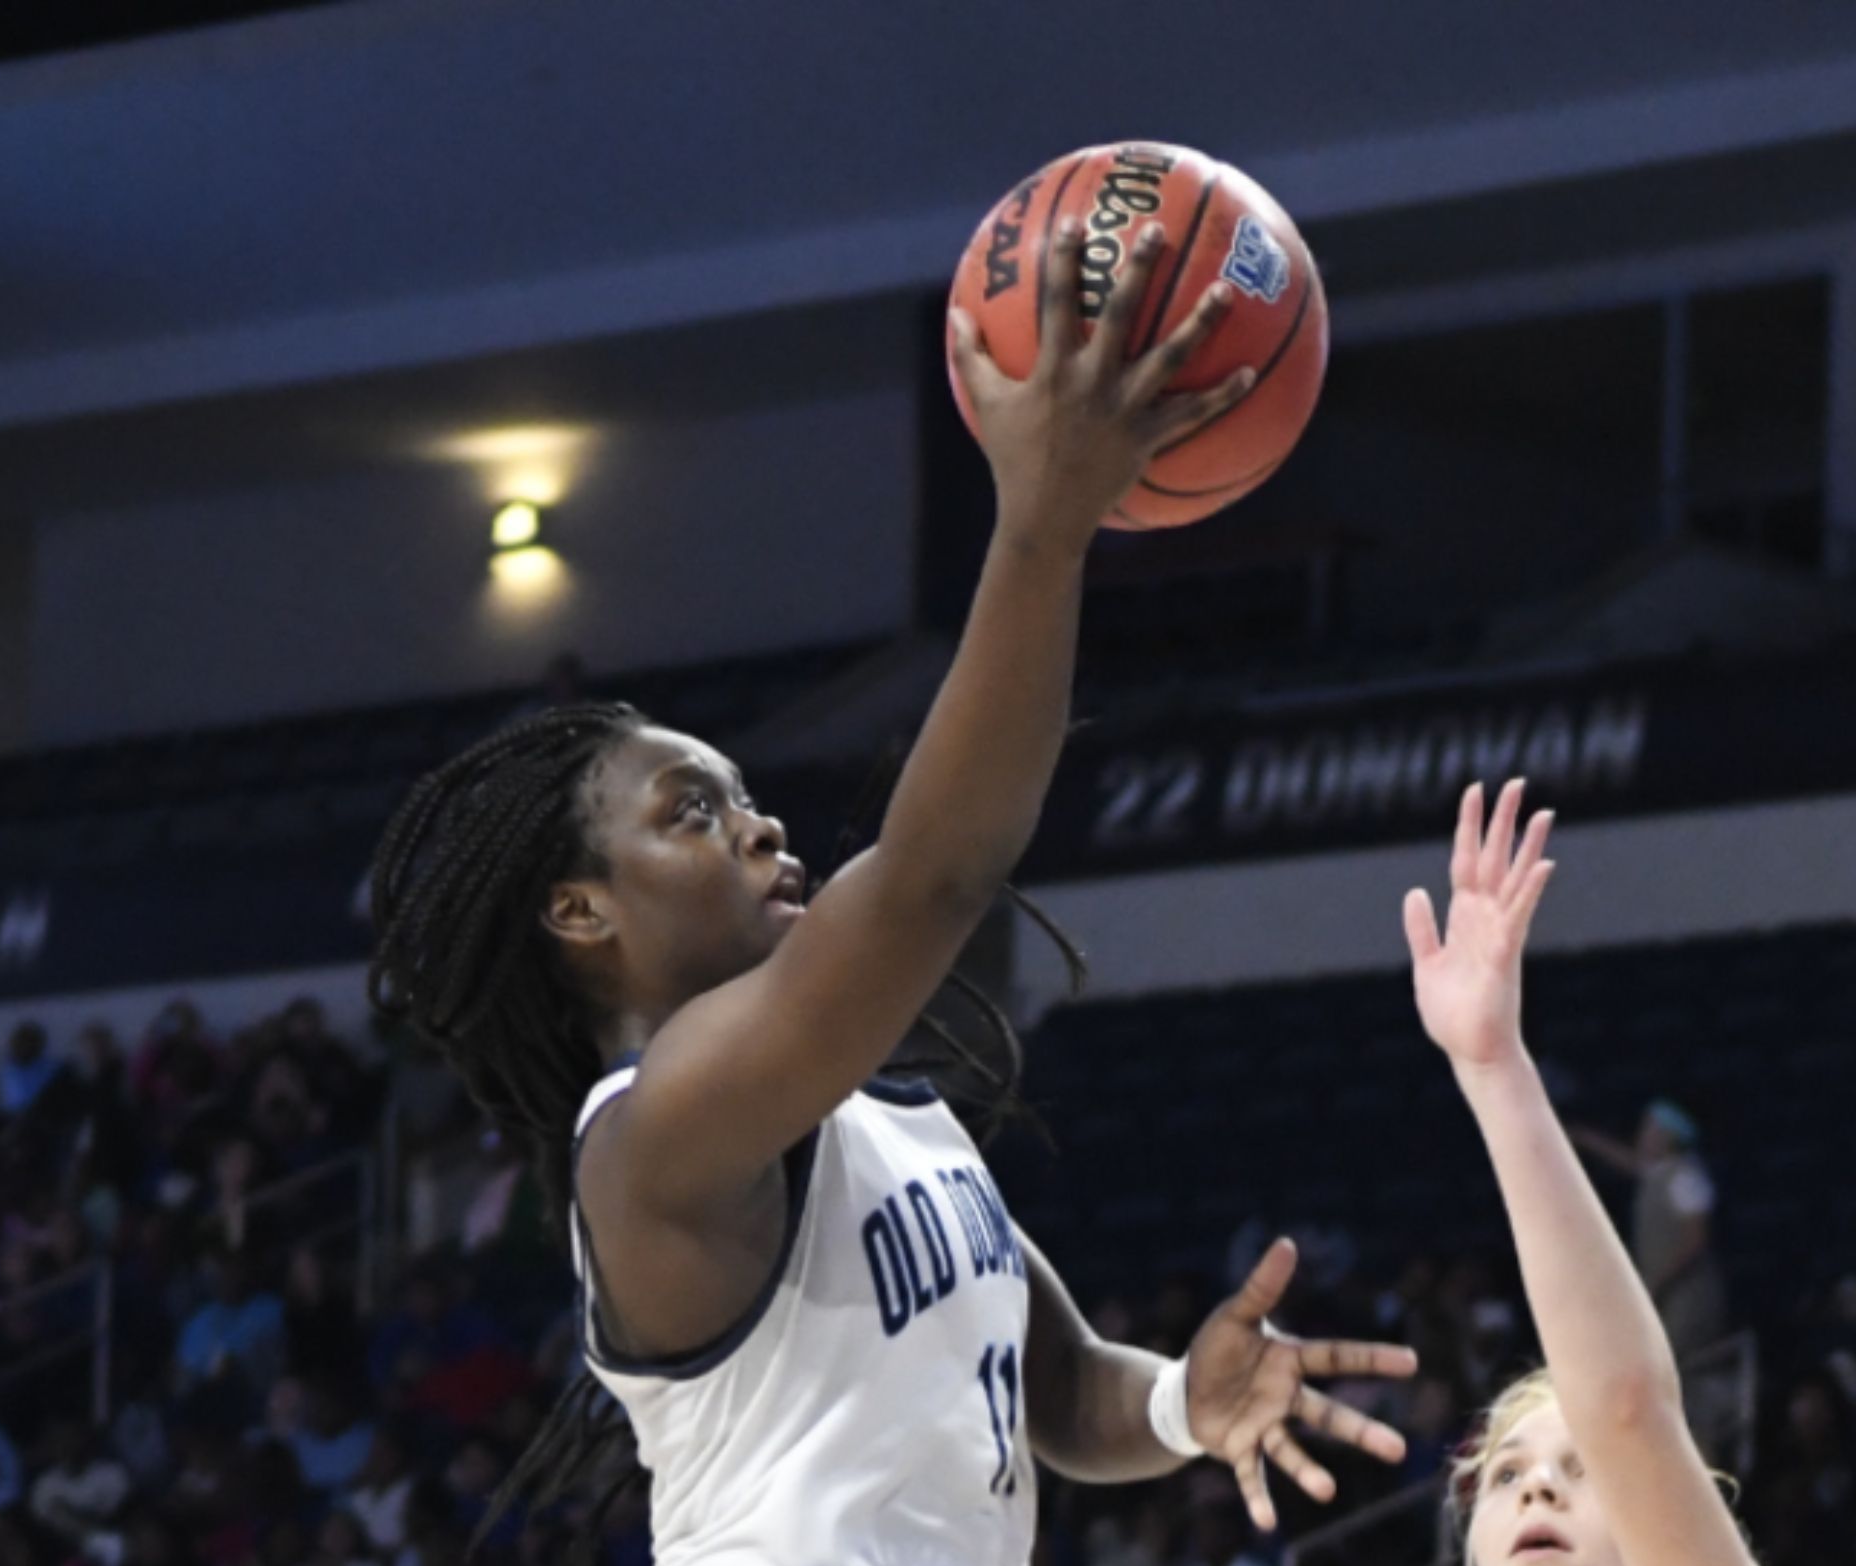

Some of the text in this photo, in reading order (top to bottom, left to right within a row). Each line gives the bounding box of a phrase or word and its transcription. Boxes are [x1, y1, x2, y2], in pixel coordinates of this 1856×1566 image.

[1094, 695, 1646, 845] 22 DONOVAN
[861, 1178, 957, 1337] OLD
